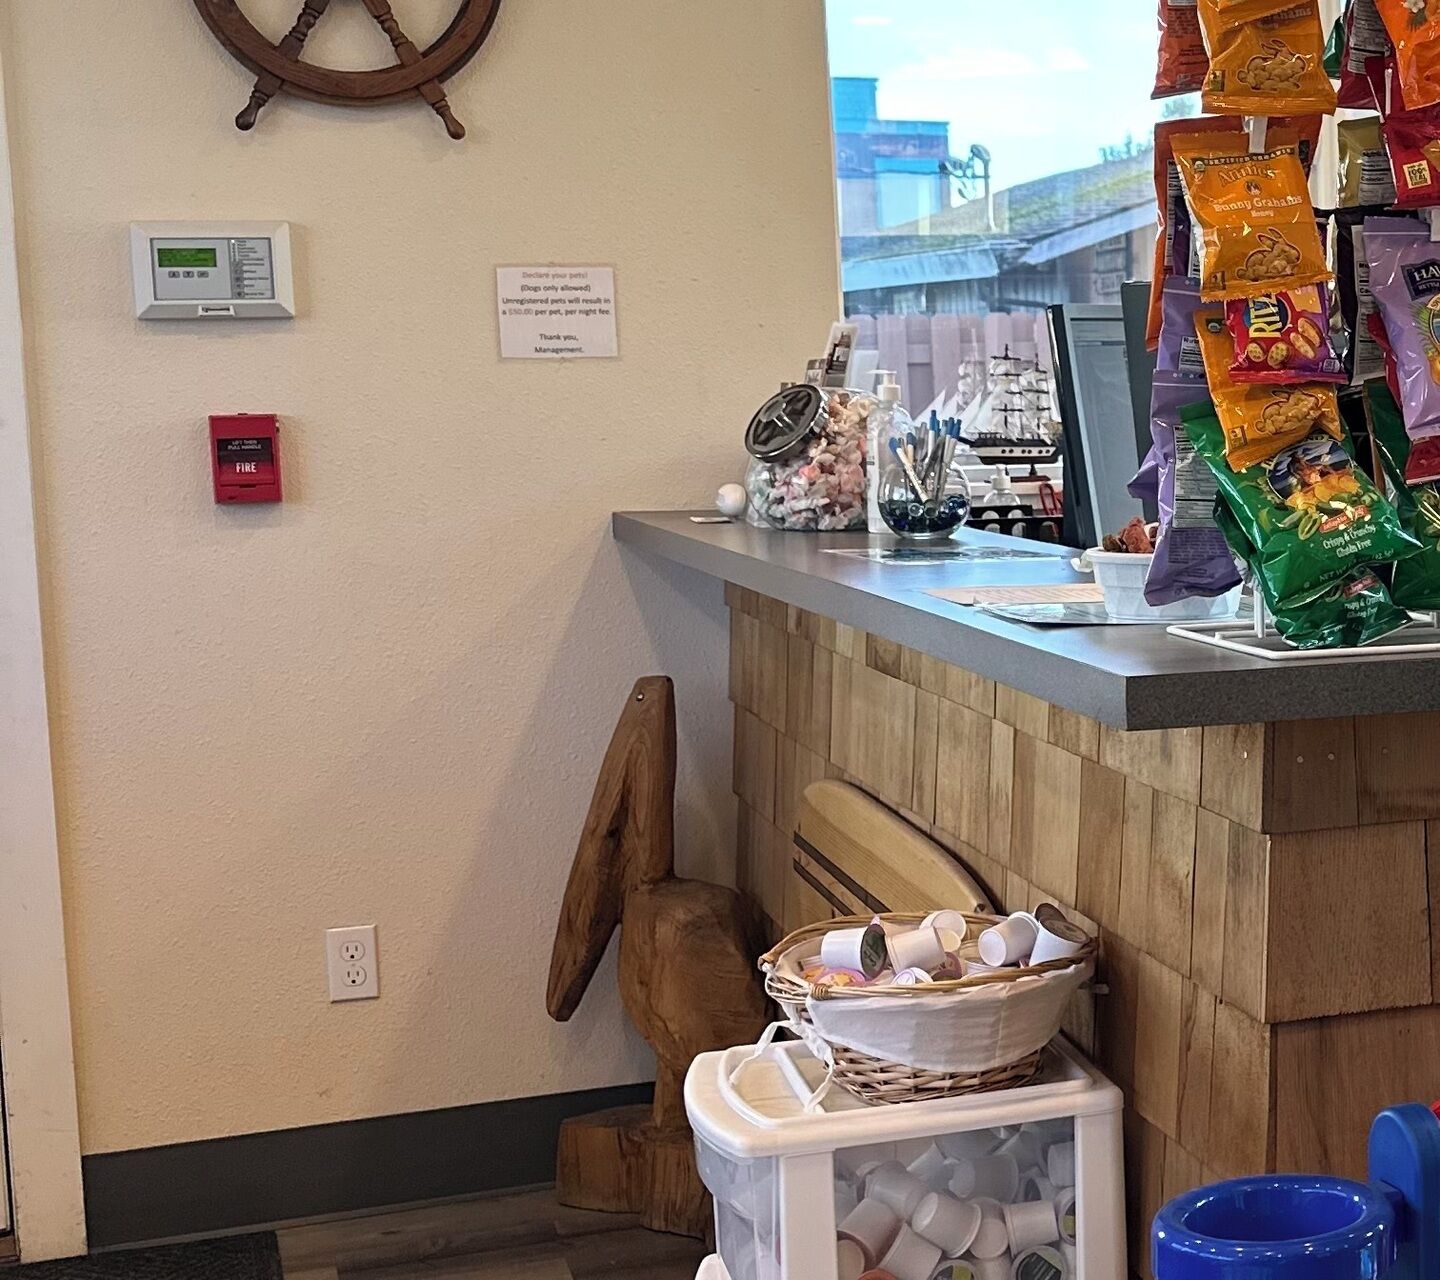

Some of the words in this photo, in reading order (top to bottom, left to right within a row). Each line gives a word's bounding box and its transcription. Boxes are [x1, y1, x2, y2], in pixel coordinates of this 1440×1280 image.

[1213, 201, 1250, 213] Bunny
[502, 297, 549, 305] Unregistered
[578, 308, 597, 316] night
[236, 462, 257, 473] FIRE
